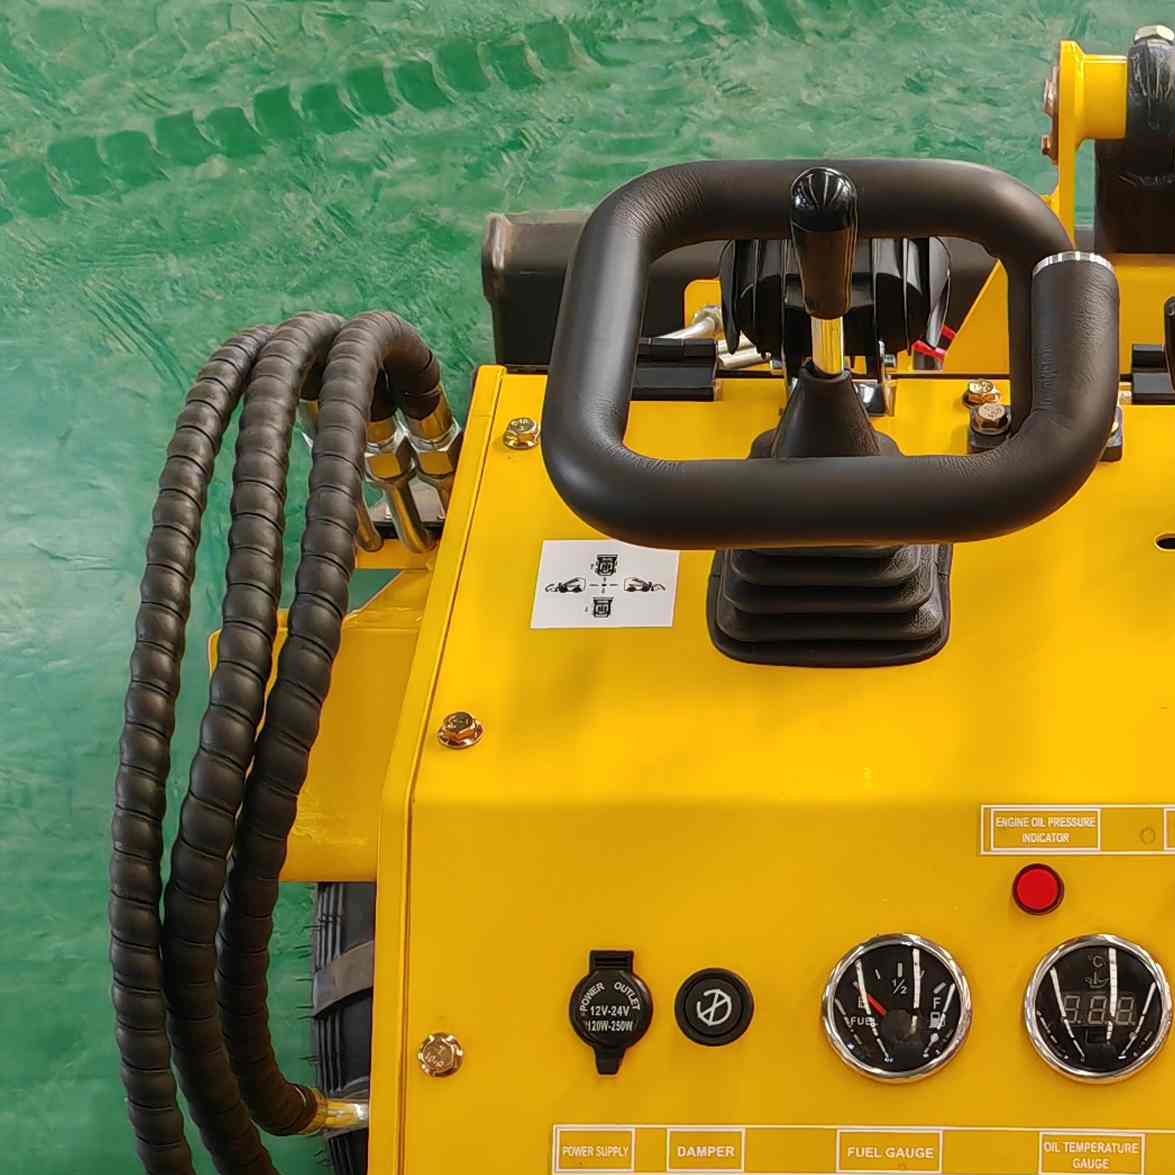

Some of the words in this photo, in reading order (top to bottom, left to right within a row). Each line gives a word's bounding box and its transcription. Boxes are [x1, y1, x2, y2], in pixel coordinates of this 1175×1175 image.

[995, 816, 1030, 828] ENGINE
[1031, 816, 1046, 828] OIL
[1048, 816, 1096, 828] PRESSURE
[1022, 832, 1070, 843] INDICATOR
[579, 982, 606, 1012] POWER
[613, 981, 641, 1011] OUTLET
[933, 997, 941, 1009] F
[590, 1005, 630, 1017] 12V-24V
[586, 1020, 633, 1032] 120W-250W
[562, 1145, 594, 1157] POWER
[596, 1144, 629, 1158] SUPPLY
[677, 1146, 736, 1158] DAMPER
[847, 1146, 882, 1159] FUEL
[885, 1147, 934, 1160] GAUGE
[1044, 1142, 1060, 1153] OIL
[1063, 1142, 1139, 1154] TEMPERATURE
[1072, 1158, 1110, 1170] GAUGE
